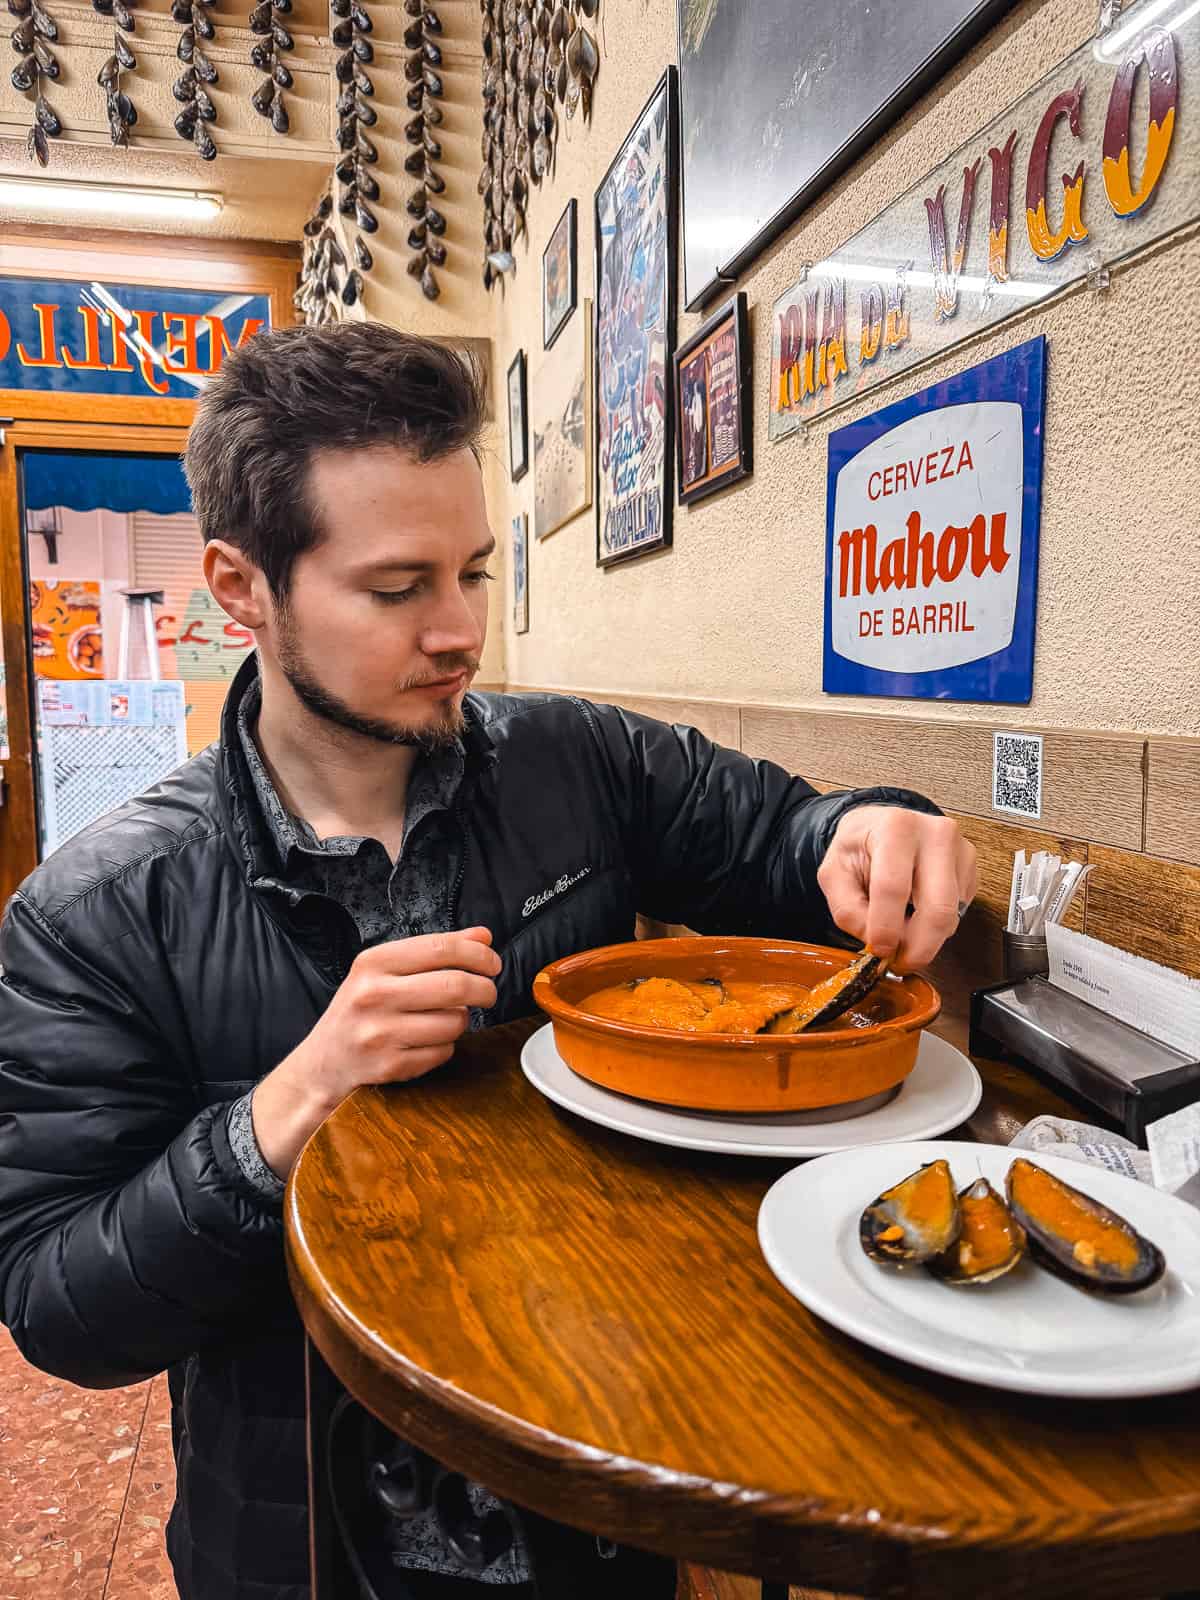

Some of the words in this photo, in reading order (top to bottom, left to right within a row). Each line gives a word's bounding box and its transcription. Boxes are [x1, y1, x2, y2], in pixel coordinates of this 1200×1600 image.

[925, 25, 1179, 321] VIGO
[867, 440, 974, 501] CERVEZA
[838, 510, 1011, 597] Mahou
[858, 609, 883, 638] DE
[892, 600, 975, 636] BARRIL
